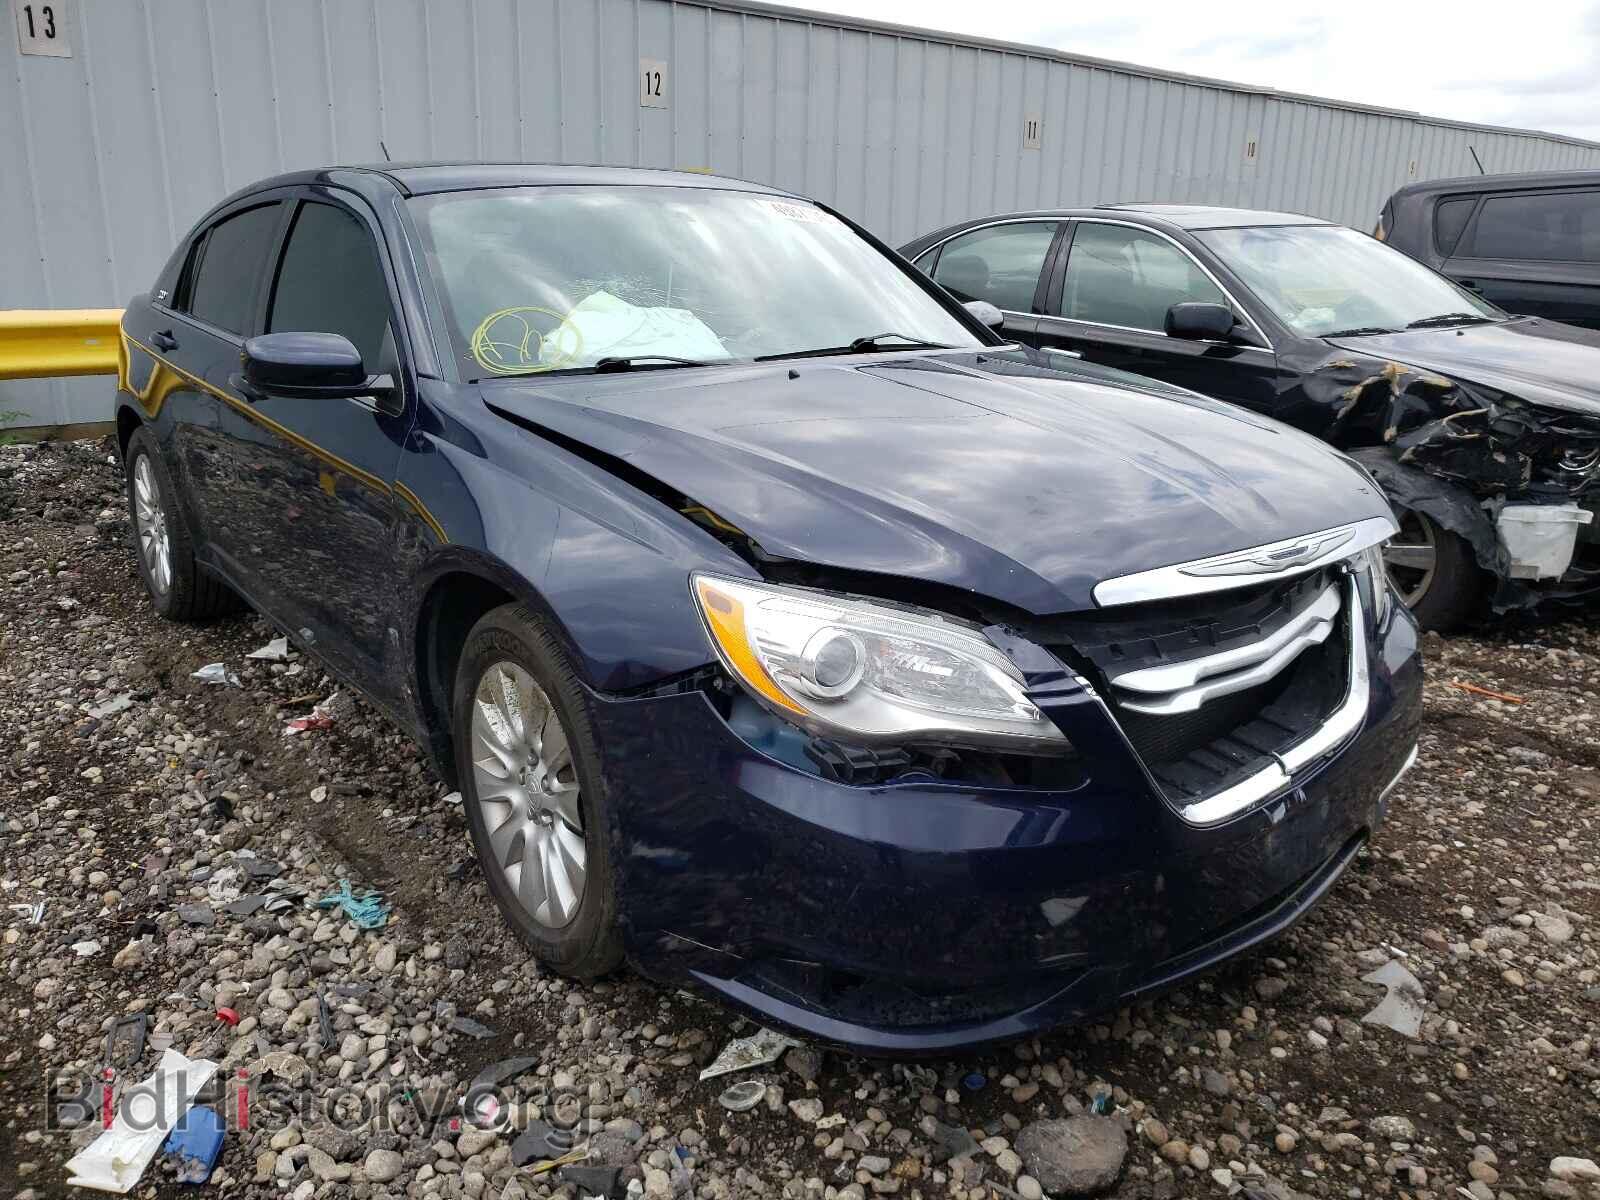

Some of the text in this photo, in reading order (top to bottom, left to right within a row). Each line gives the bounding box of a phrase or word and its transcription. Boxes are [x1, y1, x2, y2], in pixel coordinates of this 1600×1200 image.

[23, 4, 56, 39] 13
[645, 71, 661, 97] 12
[1028, 120, 1037, 140] 11
